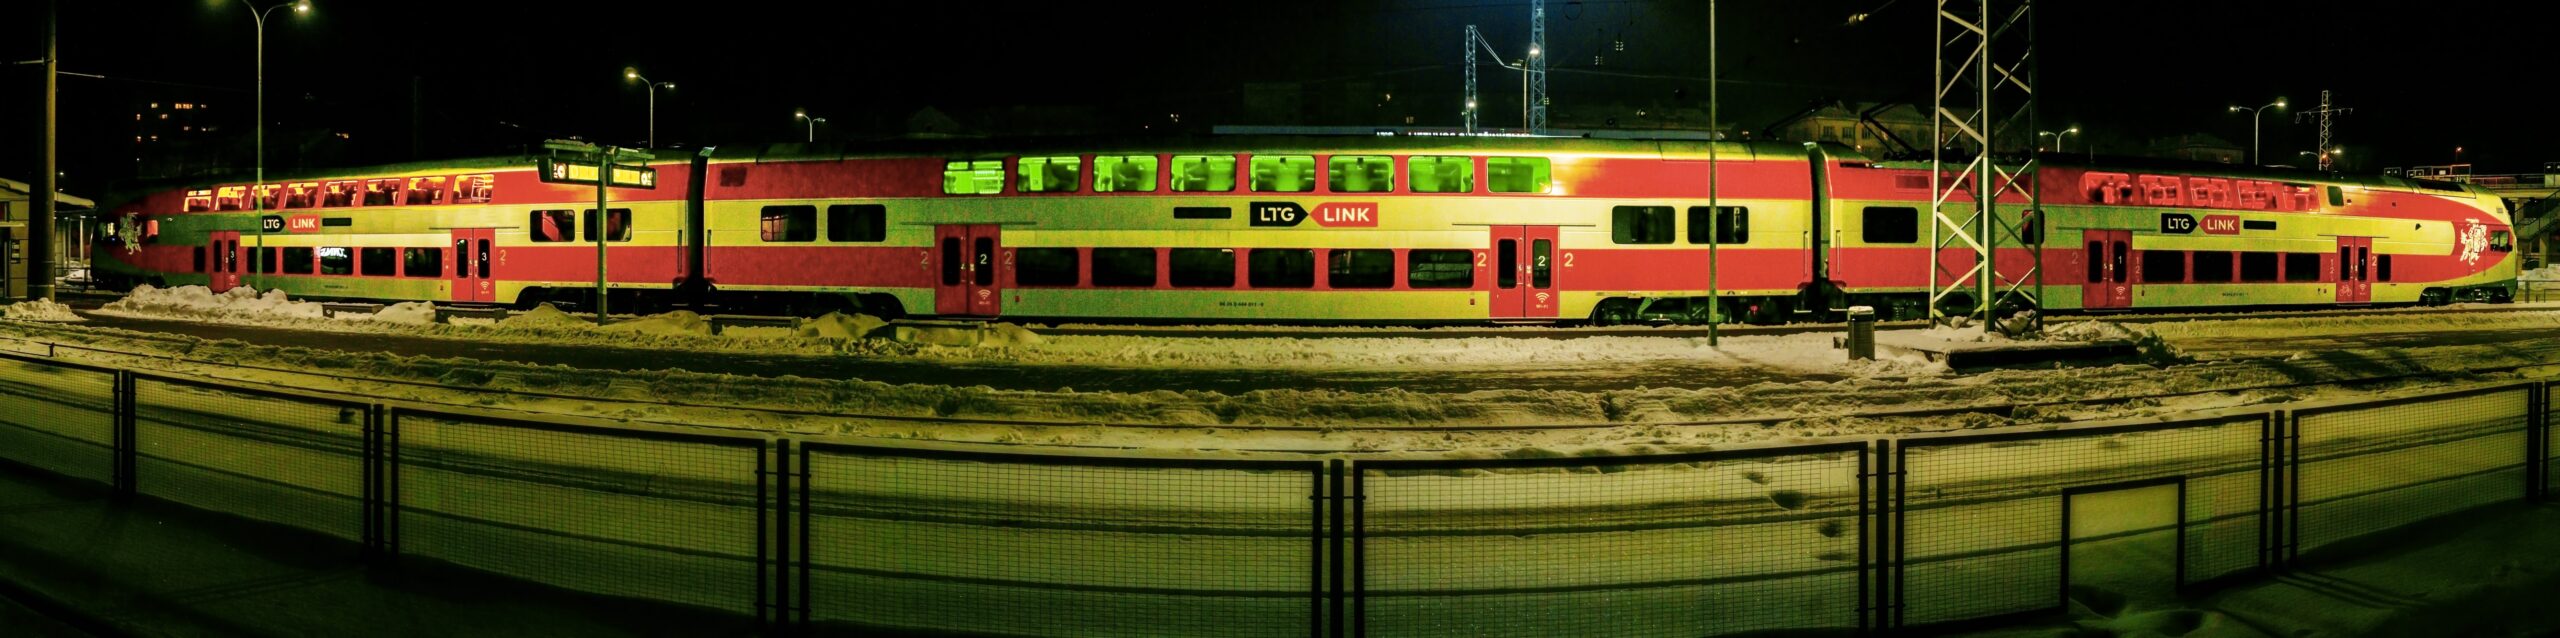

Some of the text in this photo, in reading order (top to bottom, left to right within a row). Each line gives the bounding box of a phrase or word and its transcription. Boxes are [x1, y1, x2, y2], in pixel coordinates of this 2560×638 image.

[1260, 207, 1370, 222] LTG LINK
[263, 218, 316, 229] LTG LINK
[2168, 218, 2235, 231] LTG LINK
[481, 252, 487, 261] 3
[500, 249, 506, 261] 2
[920, 251, 929, 265] 2
[980, 253, 988, 264] 2
[1004, 251, 1013, 265] 2
[1477, 252, 1487, 267] 2
[1538, 255, 1546, 267] 2
[1564, 252, 1574, 267] 2
[2071, 252, 2079, 264] 2
[2118, 255, 2122, 264] 1
[2372, 256, 2377, 266] 2
[2361, 258, 2365, 266] 1
[2136, 266, 2140, 274] 2
